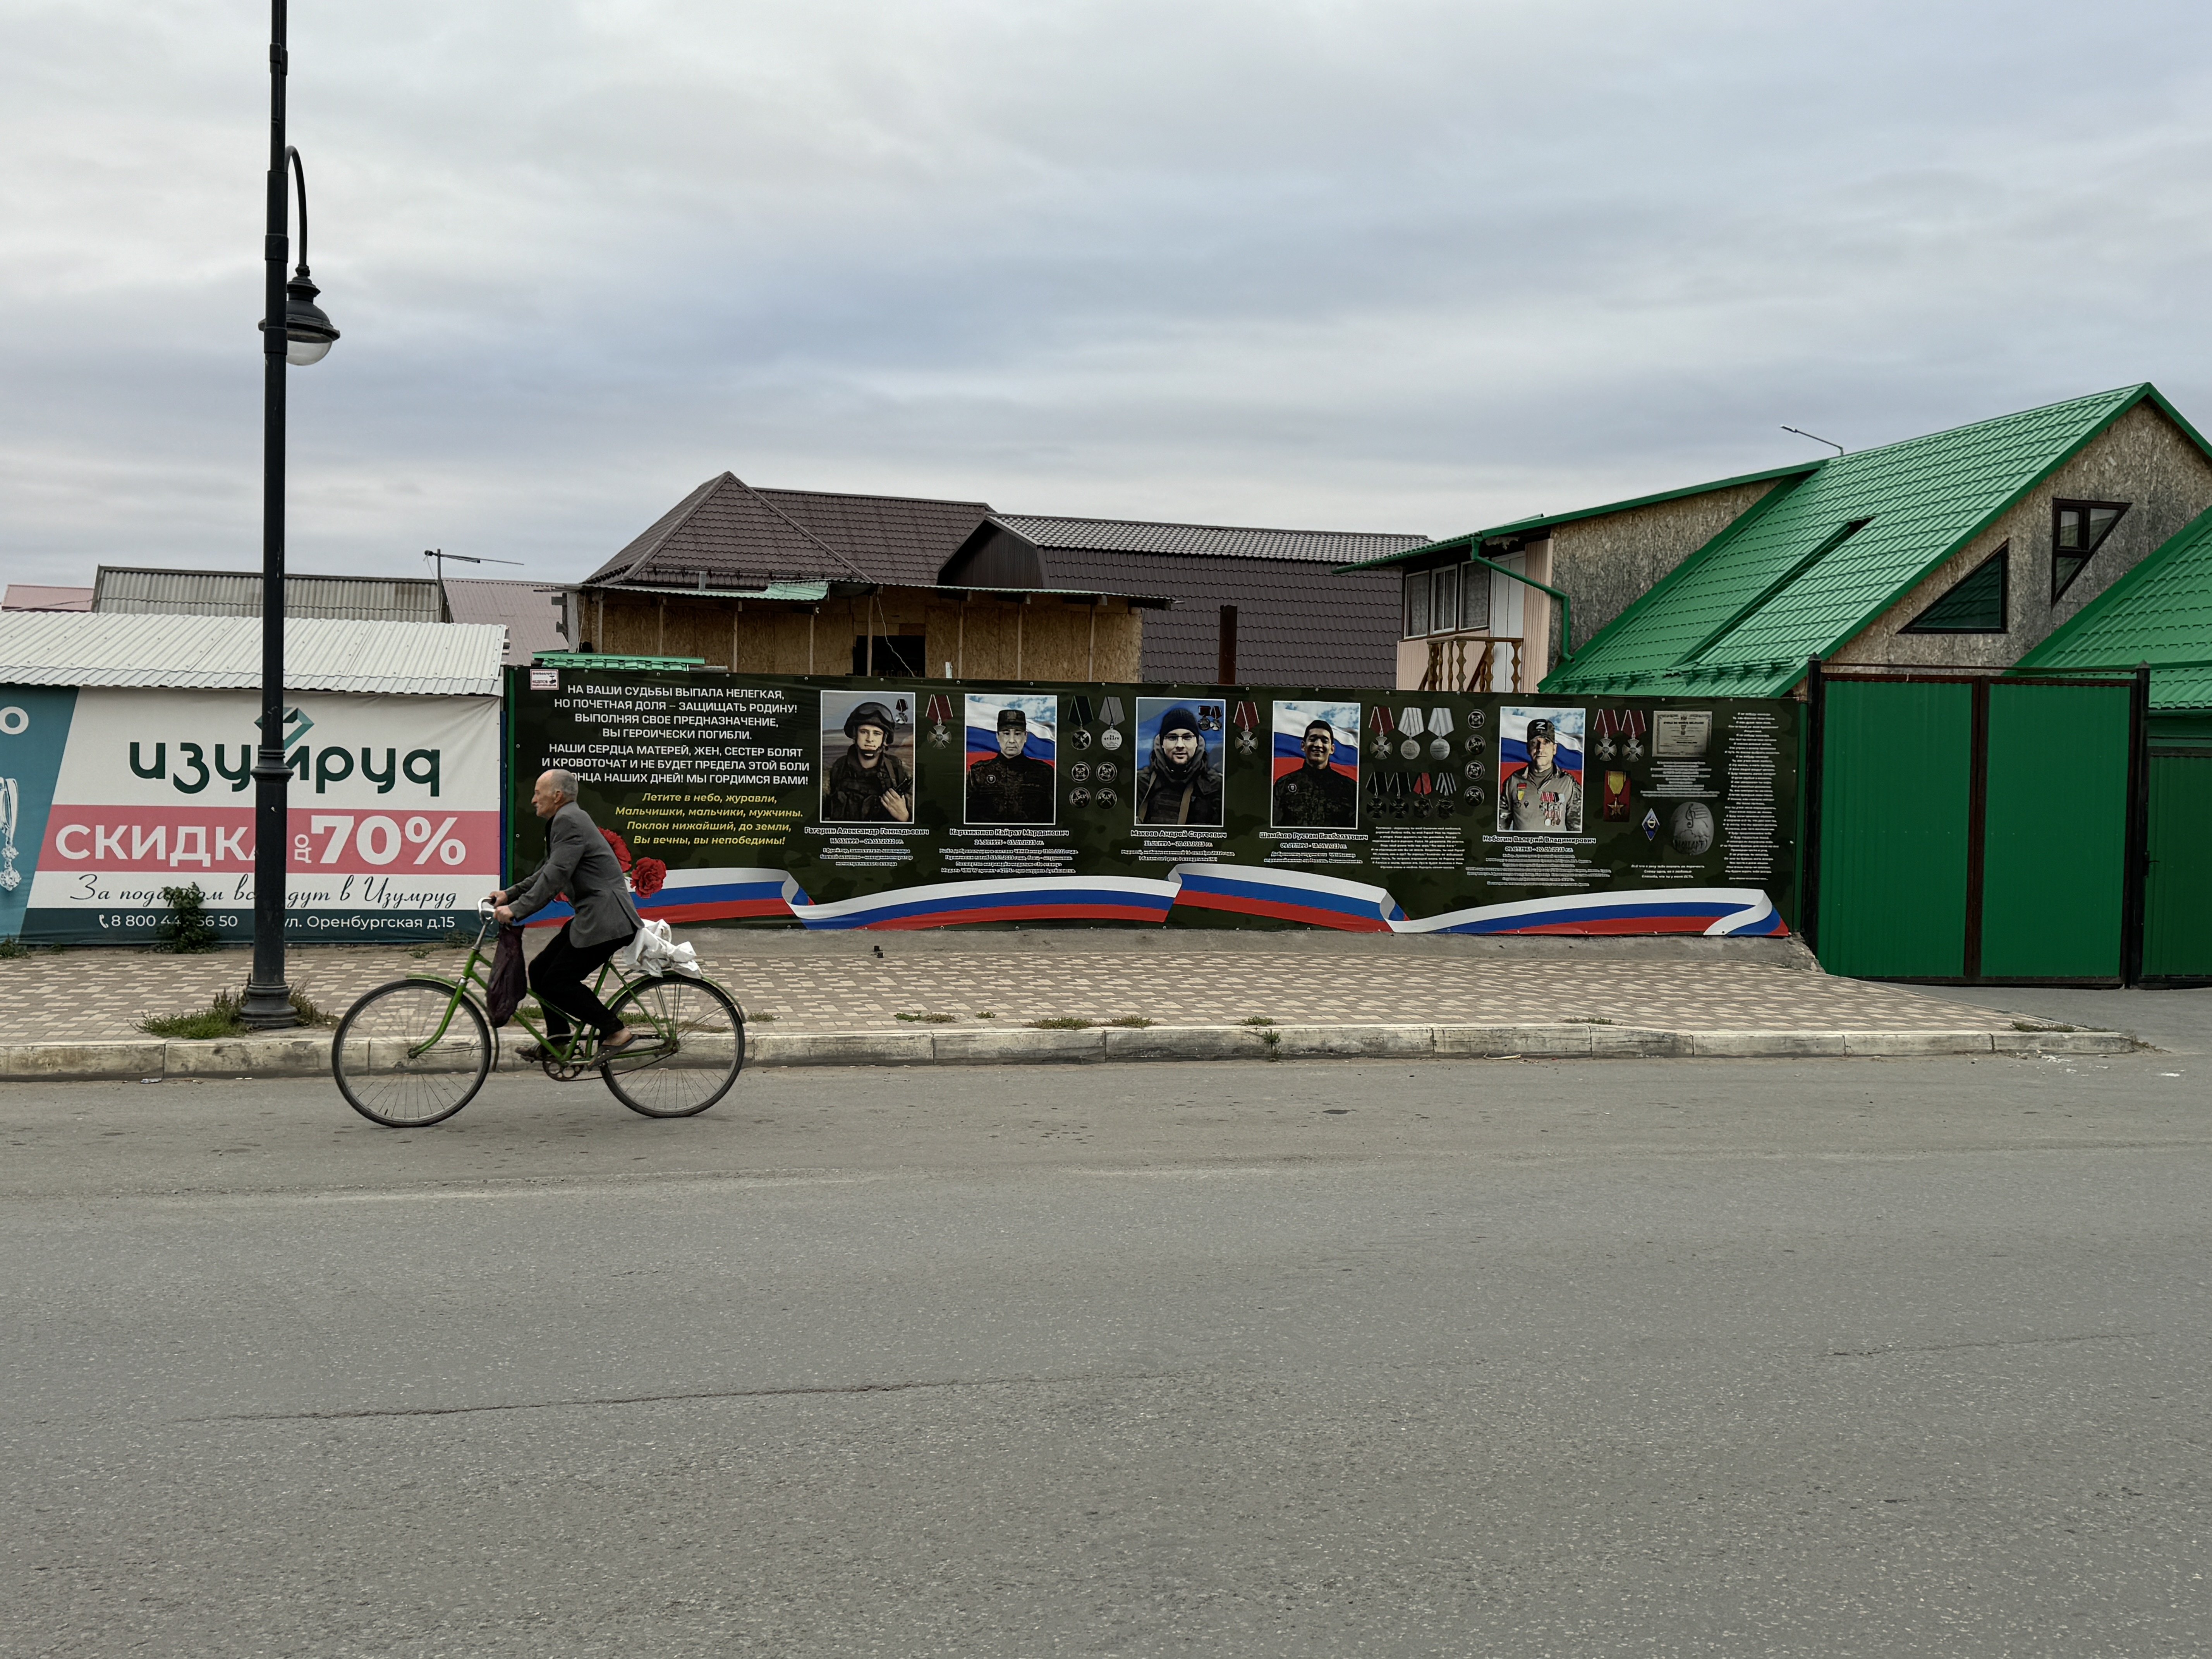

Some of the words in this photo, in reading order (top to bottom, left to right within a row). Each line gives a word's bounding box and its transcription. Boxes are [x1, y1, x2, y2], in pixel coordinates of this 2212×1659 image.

[568, 685, 584, 694] НА
[586, 685, 622, 695] ВАШИ
[625, 687, 672, 697] СУДЬБЫ
[675, 688, 724, 697] ВЫПАЛА
[726, 689, 784, 700] НЕЛЕГКАЯ,
[555, 699, 570, 708] НО
[573, 699, 632, 709] ПОЧЕТНАЯ
[635, 701, 666, 711] ДОЛЯ
[679, 702, 747, 713] ЗАЩИЩАТЬ
[749, 703, 797, 714] РОДИНУ!
[575, 713, 639, 724] ВЫПОЛНЯЯ
[642, 715, 671, 724] СВОЕ
[674, 716, 778, 728] ПРЕДНАЗНАЧЕНИЕ,
[603, 728, 620, 737] ВЫ
[623, 729, 695, 738] ГЕРОИЧЕСКИ
[698, 730, 752, 740] ПОГИБЛИ.
[549, 744, 586, 753] НАШИ
[588, 744, 634, 756] СЕРДЦА
[637, 744, 691, 756] МАТЕРЕЙ,
[694, 746, 721, 756] ЖЕН,
[725, 747, 764, 756] СЕСТЕР
[767, 748, 803, 757] БОЛЯТ
[542, 757, 550, 767] И
[553, 758, 627, 768] КРОВОТОЧАТ
[630, 760, 638, 768] И
[641, 760, 655, 768] НЕ
[658, 760, 693, 771] БУДЕТ
[695, 760, 746, 771] ПРЕДЕЛА
[749, 760, 777, 770] ЭТОЙ
[780, 762, 809, 771] БОЛИ
[571, 772, 601, 783] ОНЦА
[605, 773, 647, 782] НАШИХ
[650, 774, 684, 784] ДНЕЙ!
[687, 774, 707, 783] МЫ
[709, 775, 770, 785] ГОРДИМСЯ
[773, 776, 808, 785] ВАМИ!
[642, 793, 682, 801] Летите
[694, 793, 723, 803] небо,
[725, 795, 777, 804] журавли,
[615, 807, 685, 817] Мальчишки,
[689, 809, 746, 817] мальчики,
[749, 810, 803, 818] мужчины.
[627, 821, 669, 830] Поклон
[672, 821, 736, 831] нижайший,
[755, 824, 791, 832] земли,
[836, 827, 879, 836] Александр
[880, 828, 929, 836] Геннадьевич
[994, 828, 1022, 837] Кайрат
[55, 824, 255, 867] СКИДК
[311, 815, 466, 865] 70%
[634, 836, 650, 844] Вы
[653, 837, 690, 845] вечны,
[711, 836, 785, 845] непобедимы!
[1188, 831, 1227, 839] Сергеевич
[1513, 836, 1544, 844] Валерий
[1544, 836, 1596, 845] Владимирович
[70, 874, 110, 900] За
[285, 891, 330, 908] дут
[340, 874, 354, 901] в
[364, 876, 457, 909] Изумруд
[111, 915, 121, 927] 8
[125, 915, 156, 927] 800
[218, 915, 238, 927] 50
[307, 915, 422, 930] Оренбургская
[427, 916, 455, 929] д.15
